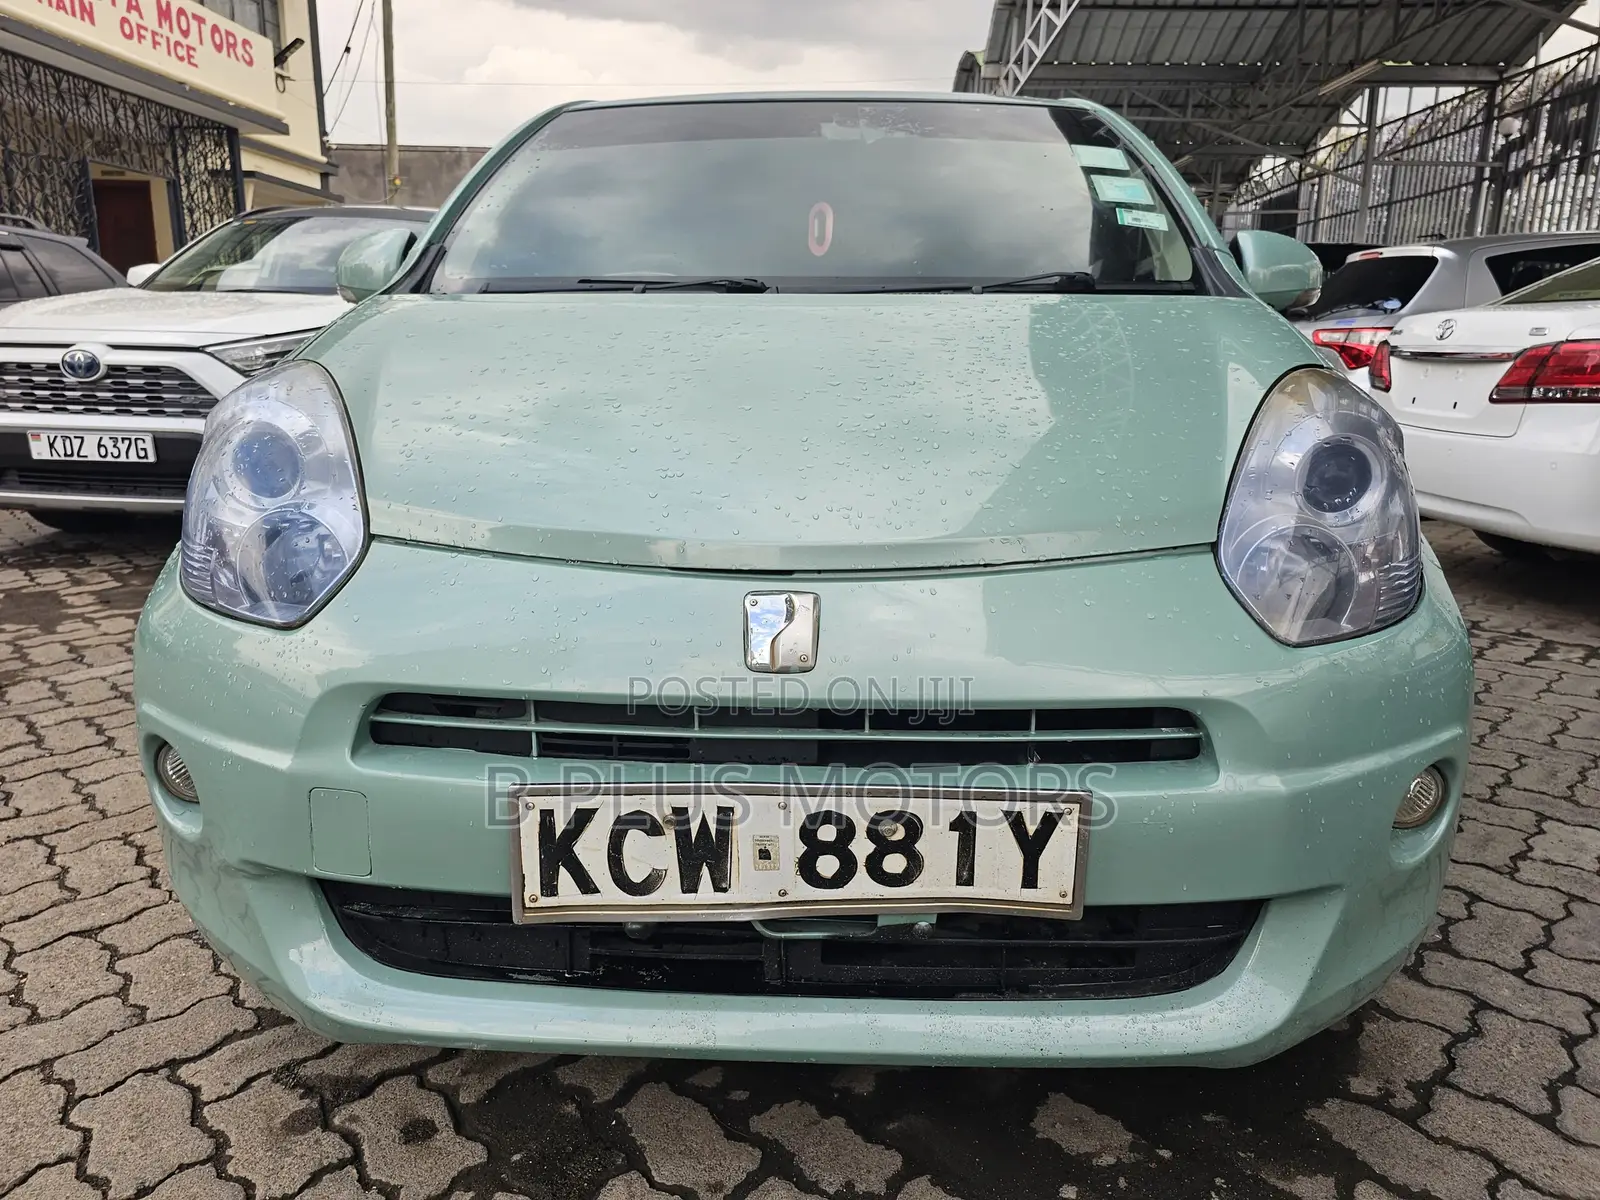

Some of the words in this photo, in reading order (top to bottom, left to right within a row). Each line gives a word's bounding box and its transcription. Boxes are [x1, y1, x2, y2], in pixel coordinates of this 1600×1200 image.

[37, 0, 96, 27] AIN
[119, 16, 199, 68] OFFICE
[110, 0, 144, 21] A
[155, 0, 254, 67] MOTORS
[47, 435, 88, 458] KDZ
[97, 436, 149, 460] 637G
[538, 806, 735, 897] KCW
[798, 809, 1064, 890] 881Y
